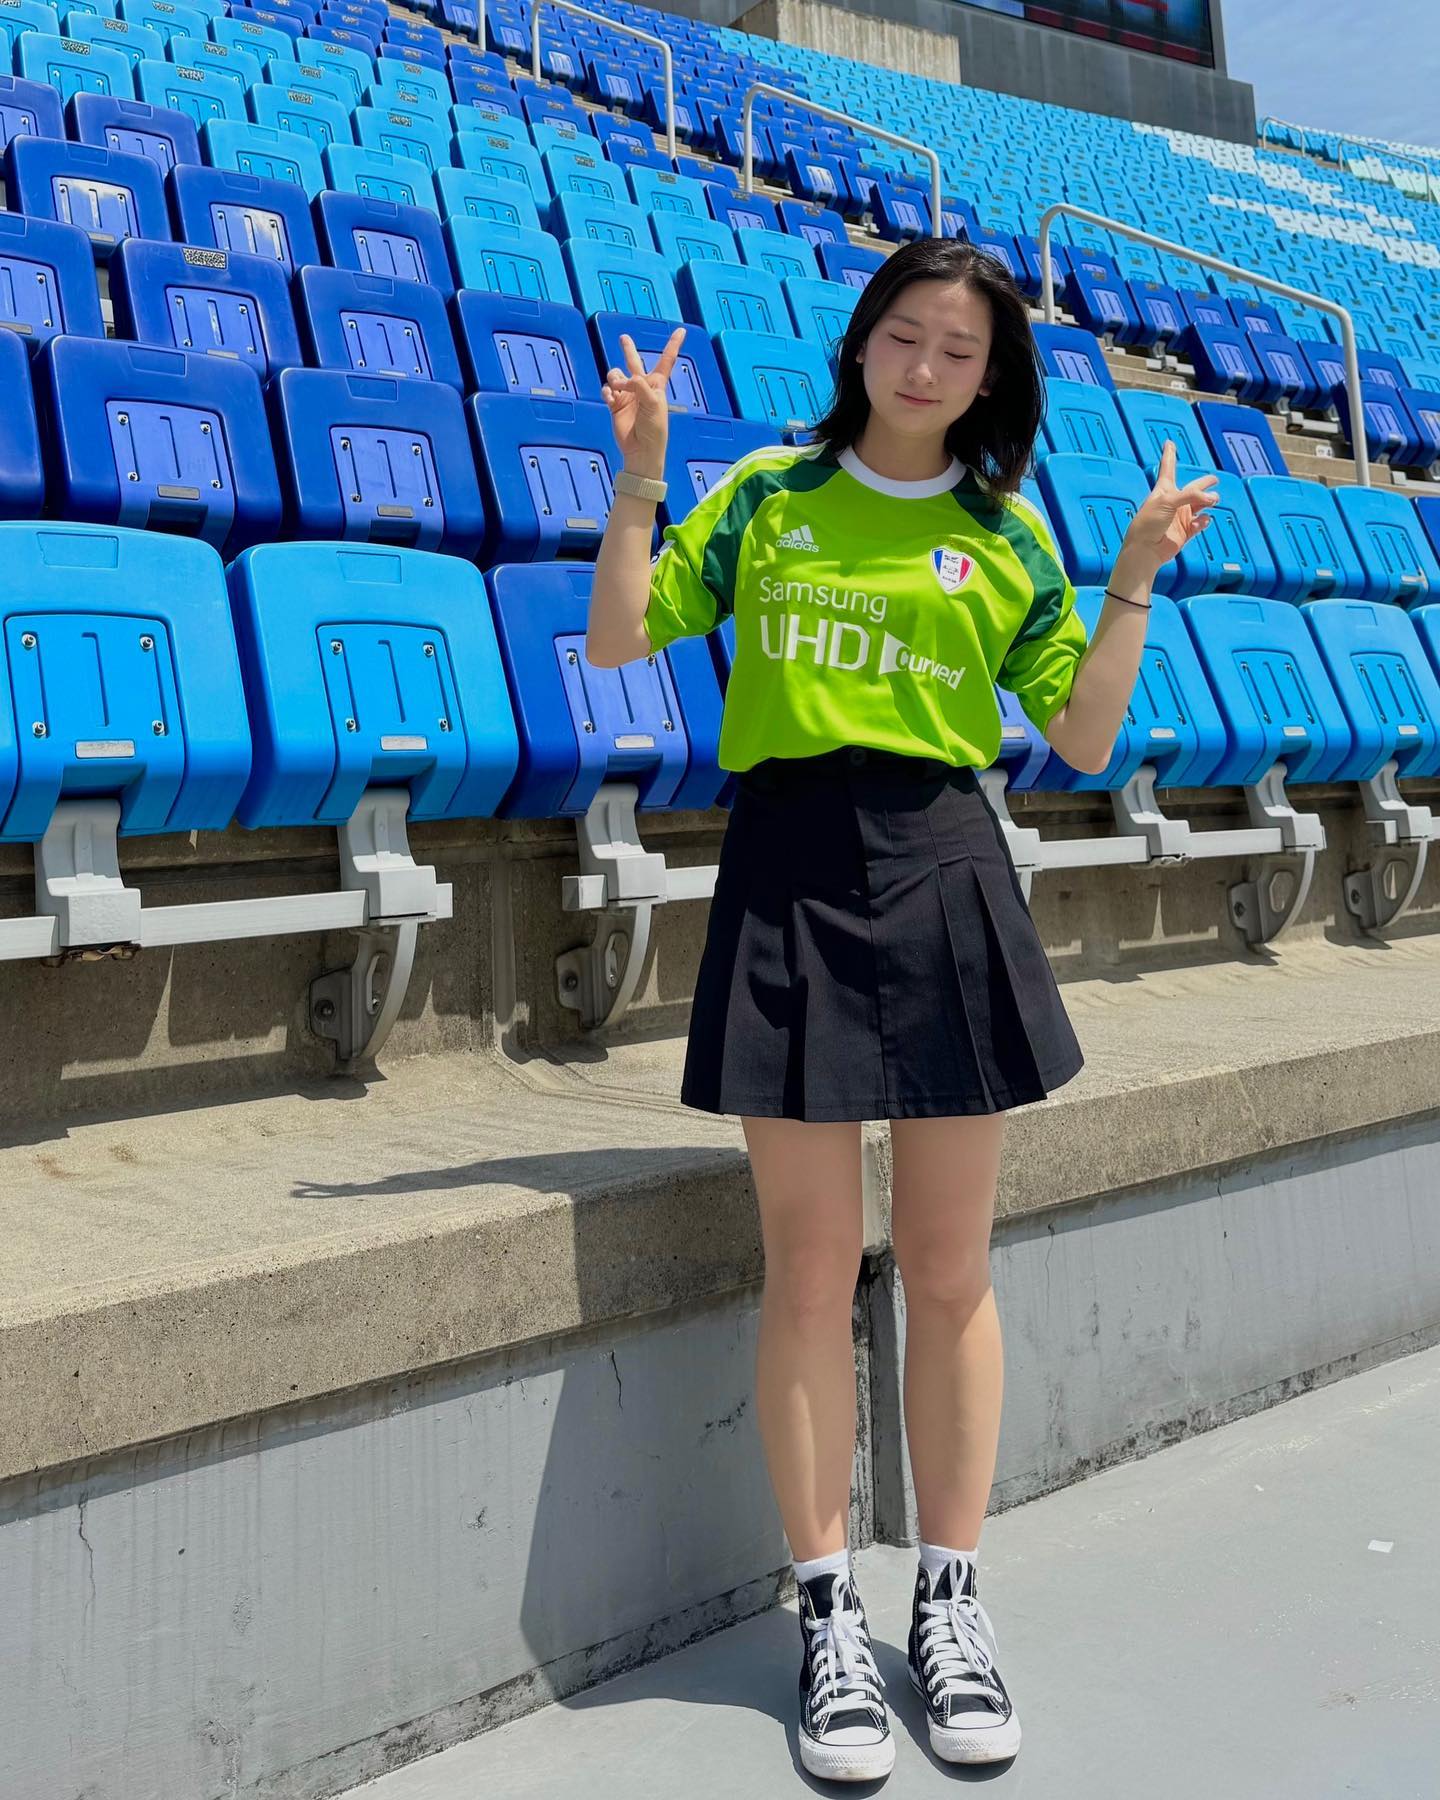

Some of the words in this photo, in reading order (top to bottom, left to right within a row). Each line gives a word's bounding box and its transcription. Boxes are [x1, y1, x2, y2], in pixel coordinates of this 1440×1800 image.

[776, 537, 820, 552] adidas
[759, 576, 887, 623] Samsung
[760, 614, 870, 671] UHD
